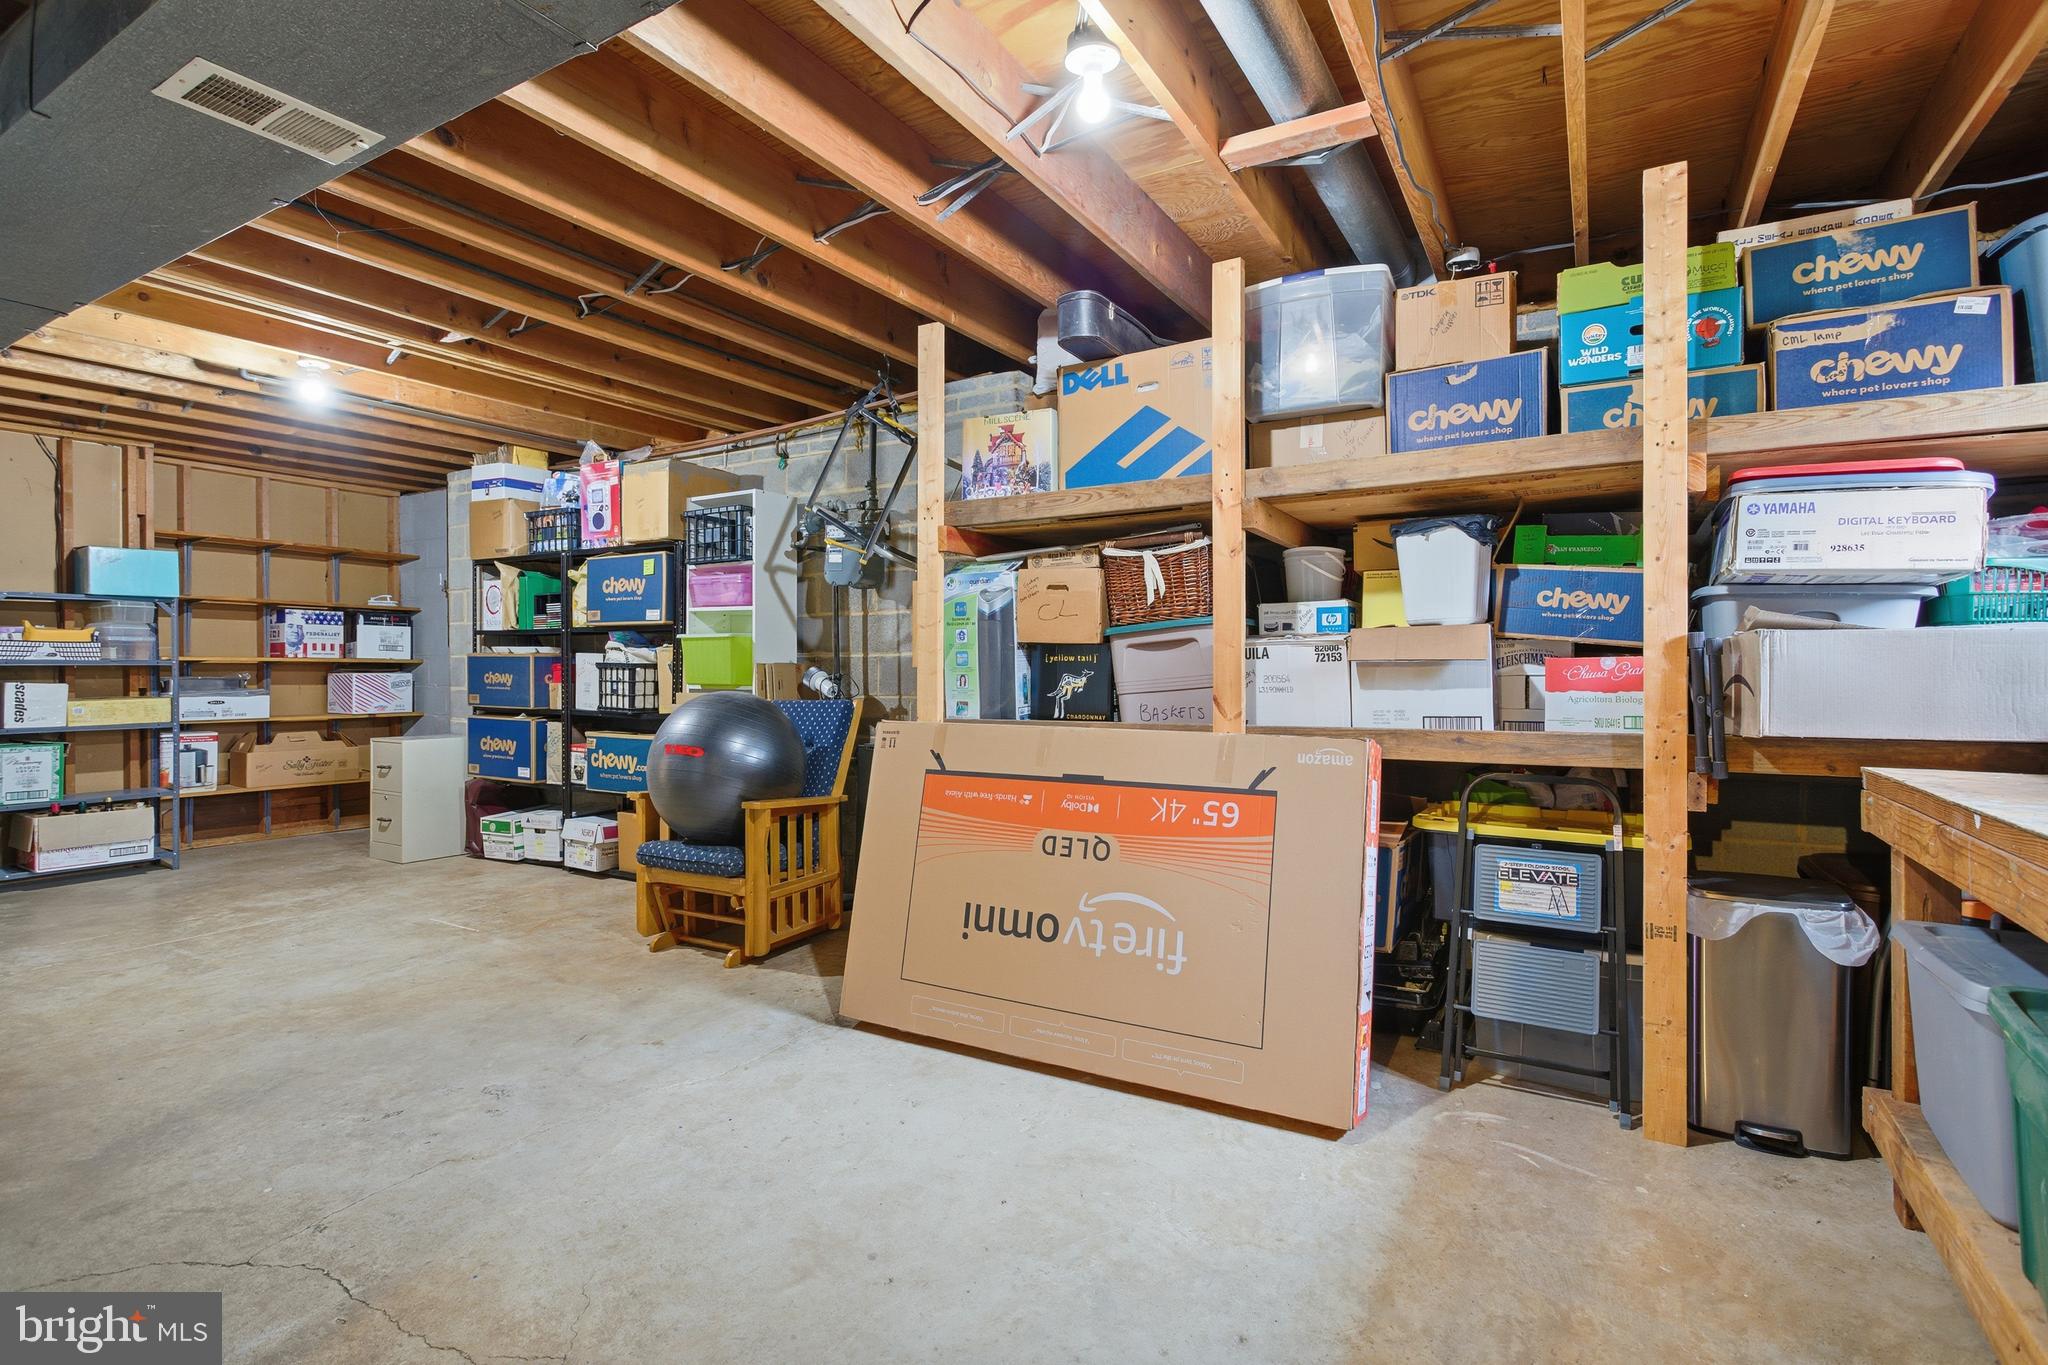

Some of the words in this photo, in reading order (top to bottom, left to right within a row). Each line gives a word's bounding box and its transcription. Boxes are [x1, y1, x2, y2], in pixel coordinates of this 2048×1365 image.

[1733, 238, 1753, 247] ALL
[1757, 231, 1793, 243] METAL
[1798, 221, 1843, 236] ESCAPE
[1848, 213, 1894, 227] LADDER
[1792, 242, 1924, 284] chewy
[1803, 285, 1833, 296] where
[1835, 282, 1853, 292] pet
[1855, 277, 1887, 287] lovers
[1888, 271, 1914, 282] shop
[1408, 288, 1437, 299] TDK
[1782, 335, 1807, 346] CML
[1813, 331, 1843, 341] lamp
[1568, 352, 1622, 367] WONDERS
[1580, 346, 1608, 357] WILD
[1810, 344, 1963, 384] chewy
[1063, 362, 1129, 396] DELL
[1822, 386, 1857, 398] where
[1859, 384, 1880, 396] pet
[1882, 379, 1918, 391] lovers
[1921, 376, 1951, 388] shop
[983, 416, 1003, 425] MILL
[1003, 413, 1031, 423] SCENE
[1408, 398, 1522, 432] chewy
[1603, 397, 1718, 428] chy
[1416, 434, 1442, 443] where
[1445, 432, 1460, 442] pet
[1461, 429, 1489, 439] lovers
[1491, 426, 1513, 435] shop
[1763, 502, 1816, 514] YAMAHA
[1838, 517, 1884, 526] DIGITAL
[1887, 514, 1957, 525] KEYBOARD
[1830, 544, 1865, 552] 928635
[602, 576, 646, 596] chewy
[1038, 600, 1078, 620] CL
[1537, 587, 1630, 615] chewy
[1326, 614, 1338, 624] hp
[1314, 653, 1342, 663] 72153
[484, 671, 513, 687] chewy
[1563, 665, 1609, 681] Chiusa
[1568, 695, 1613, 704] Agricoltura
[1139, 703, 1205, 722] BASKETS
[480, 735, 517, 756] chewy
[591, 749, 648, 774] chewy.co
[1296, 751, 1354, 766] amazon
[944, 790, 962, 798] Alexa
[979, 792, 1017, 802] Hands-free
[1061, 799, 1087, 812] Dolby
[1151, 797, 1187, 822] 4K
[1192, 800, 1240, 828] 65"
[1042, 834, 1111, 862] QLED
[1498, 868, 1578, 886] ELEVATE
[962, 902, 1060, 942] omni
